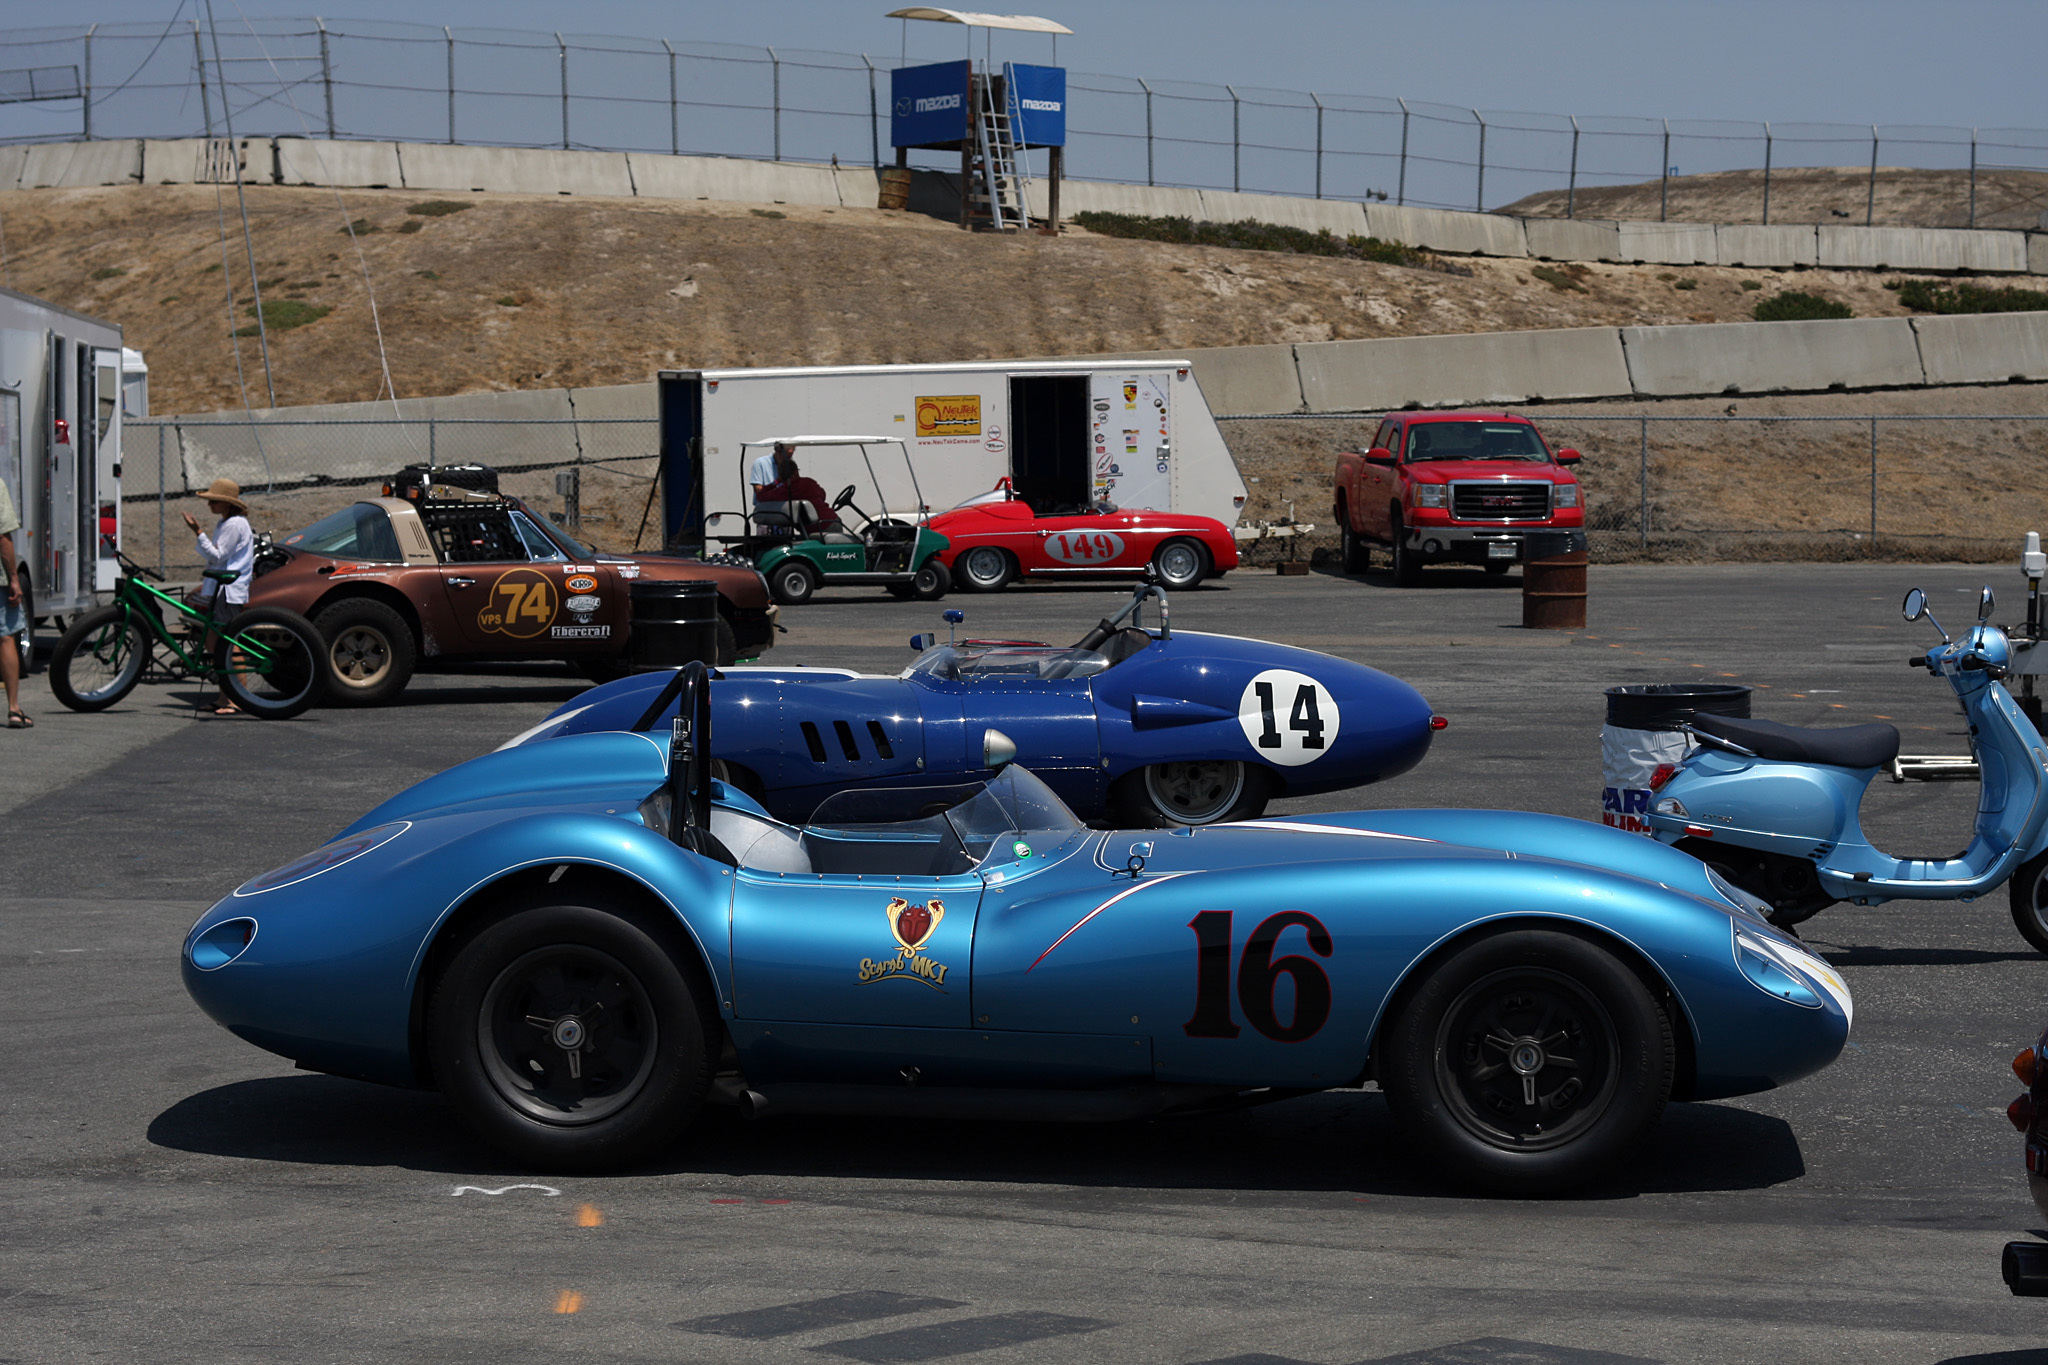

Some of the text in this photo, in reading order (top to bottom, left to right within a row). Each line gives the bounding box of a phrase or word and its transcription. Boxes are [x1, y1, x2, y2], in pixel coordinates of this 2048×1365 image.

[916, 94, 961, 112] mazda
[1022, 99, 1061, 112] mazda
[1093, 484, 1115, 496] BOSCH
[1482, 496, 1522, 506] GMC
[1058, 534, 1114, 559] 149
[499, 582, 550, 624] 74
[481, 614, 501, 625] VPS
[551, 625, 610, 637] Fibercraft
[1255, 682, 1324, 749] 14
[910, 955, 948, 985] MKI
[1182, 910, 1333, 1043] 16
